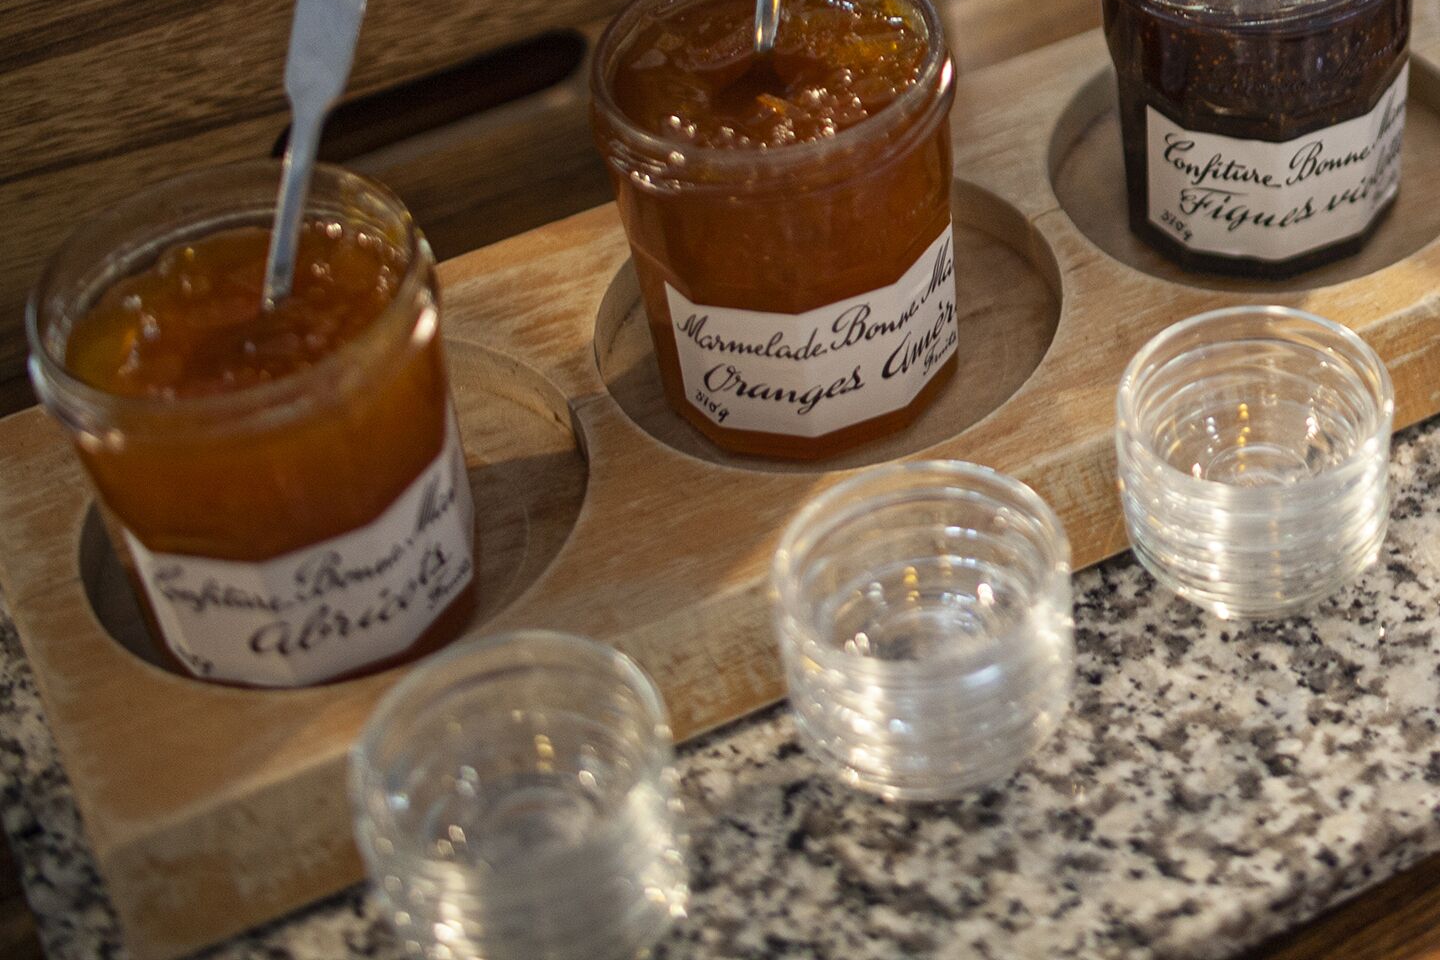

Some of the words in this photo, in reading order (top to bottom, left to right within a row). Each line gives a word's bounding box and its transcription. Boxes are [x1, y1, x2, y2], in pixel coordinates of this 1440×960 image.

[1163, 133, 1281, 188] Confiture
[1284, 140, 1374, 187] Bonne
[1180, 186, 1316, 232] Figues
[677, 313, 829, 363] Marmelade
[830, 301, 920, 351] Bonne
[703, 363, 866, 416] Oranges
